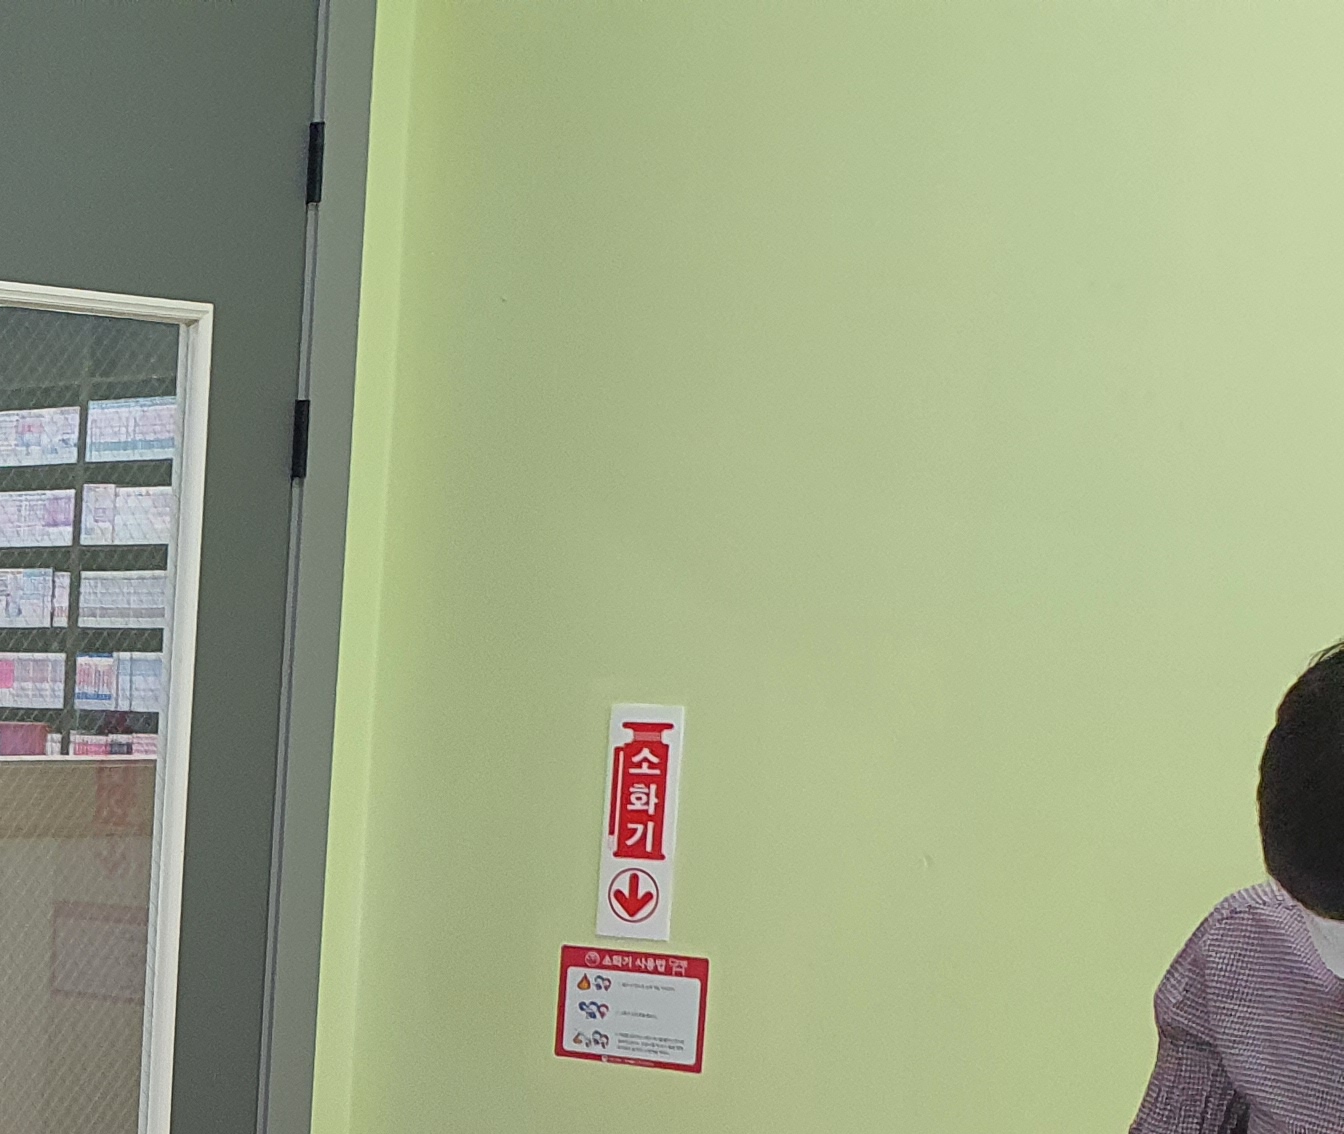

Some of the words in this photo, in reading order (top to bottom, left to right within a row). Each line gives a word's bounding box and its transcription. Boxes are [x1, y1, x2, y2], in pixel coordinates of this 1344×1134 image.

[625, 748, 661, 852] 소화기
[602, 954, 632, 968] 소화기
[635, 957, 666, 972] 사용법
